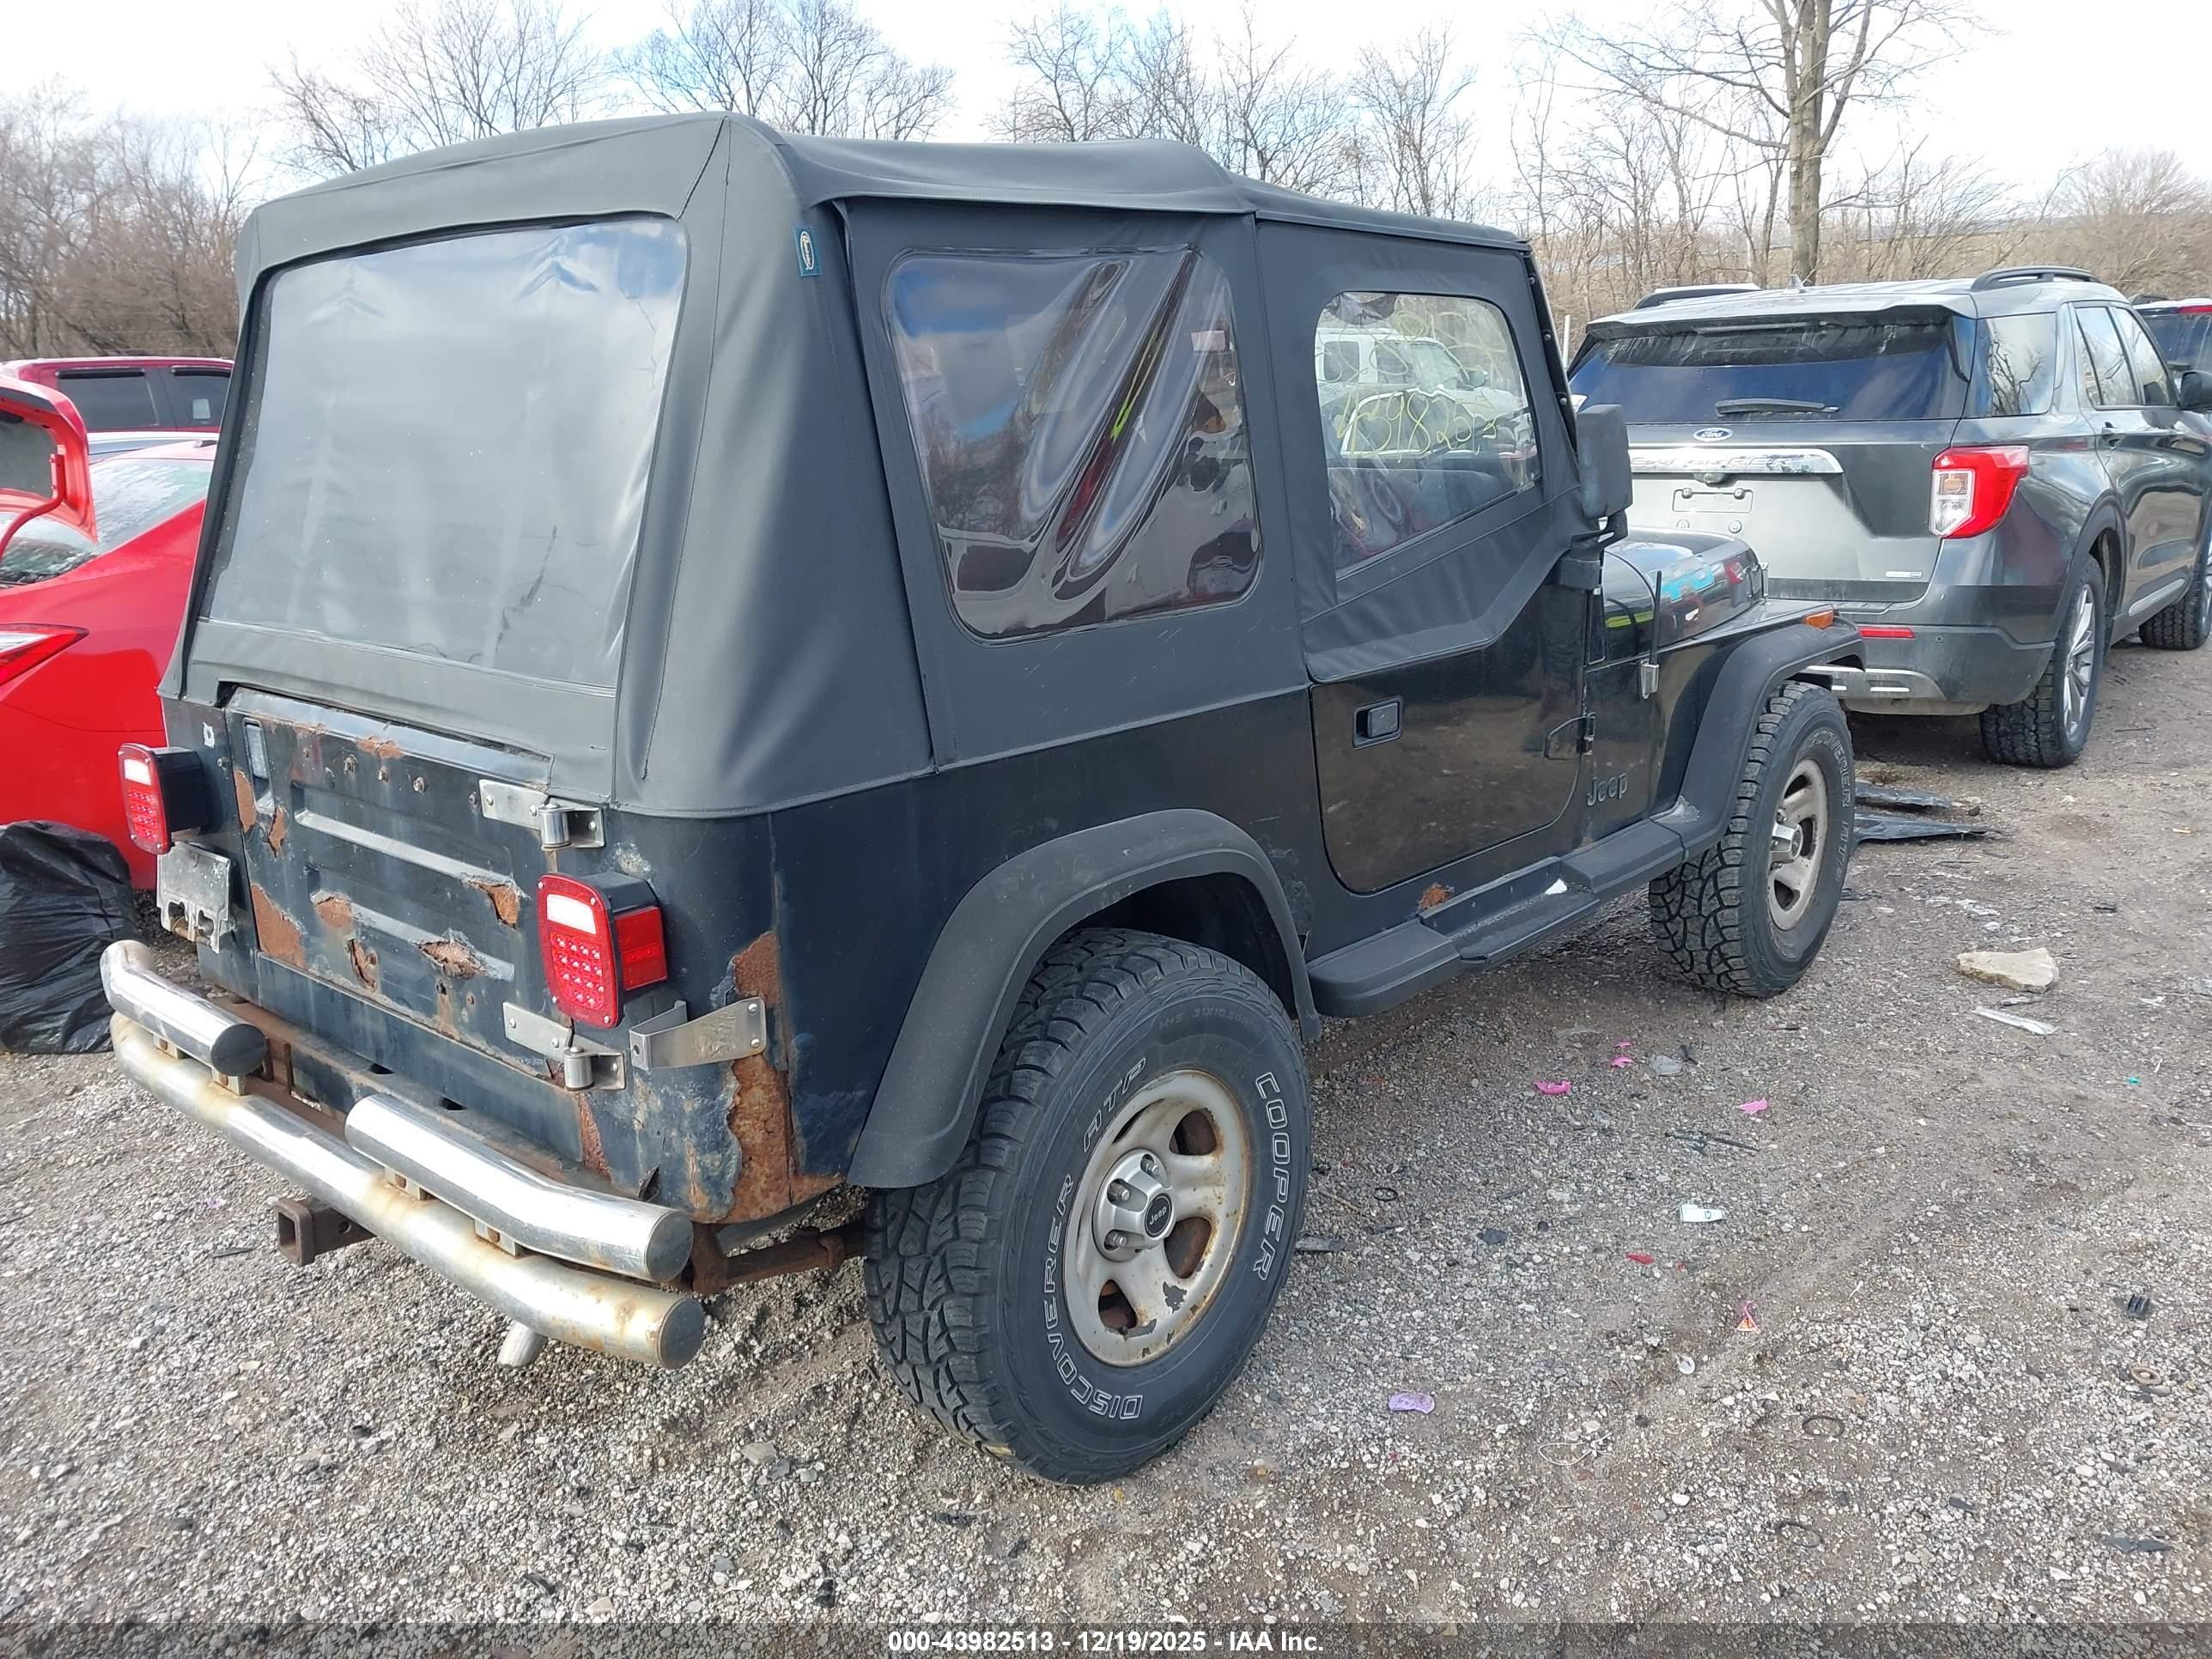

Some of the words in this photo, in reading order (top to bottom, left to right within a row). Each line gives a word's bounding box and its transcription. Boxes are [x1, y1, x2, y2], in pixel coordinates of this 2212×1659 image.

[1631, 456, 1792, 469] EXORER
[1587, 772, 1628, 805] Jeep
[1255, 1072, 1291, 1281] COOPER
[1149, 1206, 1167, 1225] Jeep
[1043, 1174, 1144, 1420] DISCOVERER
